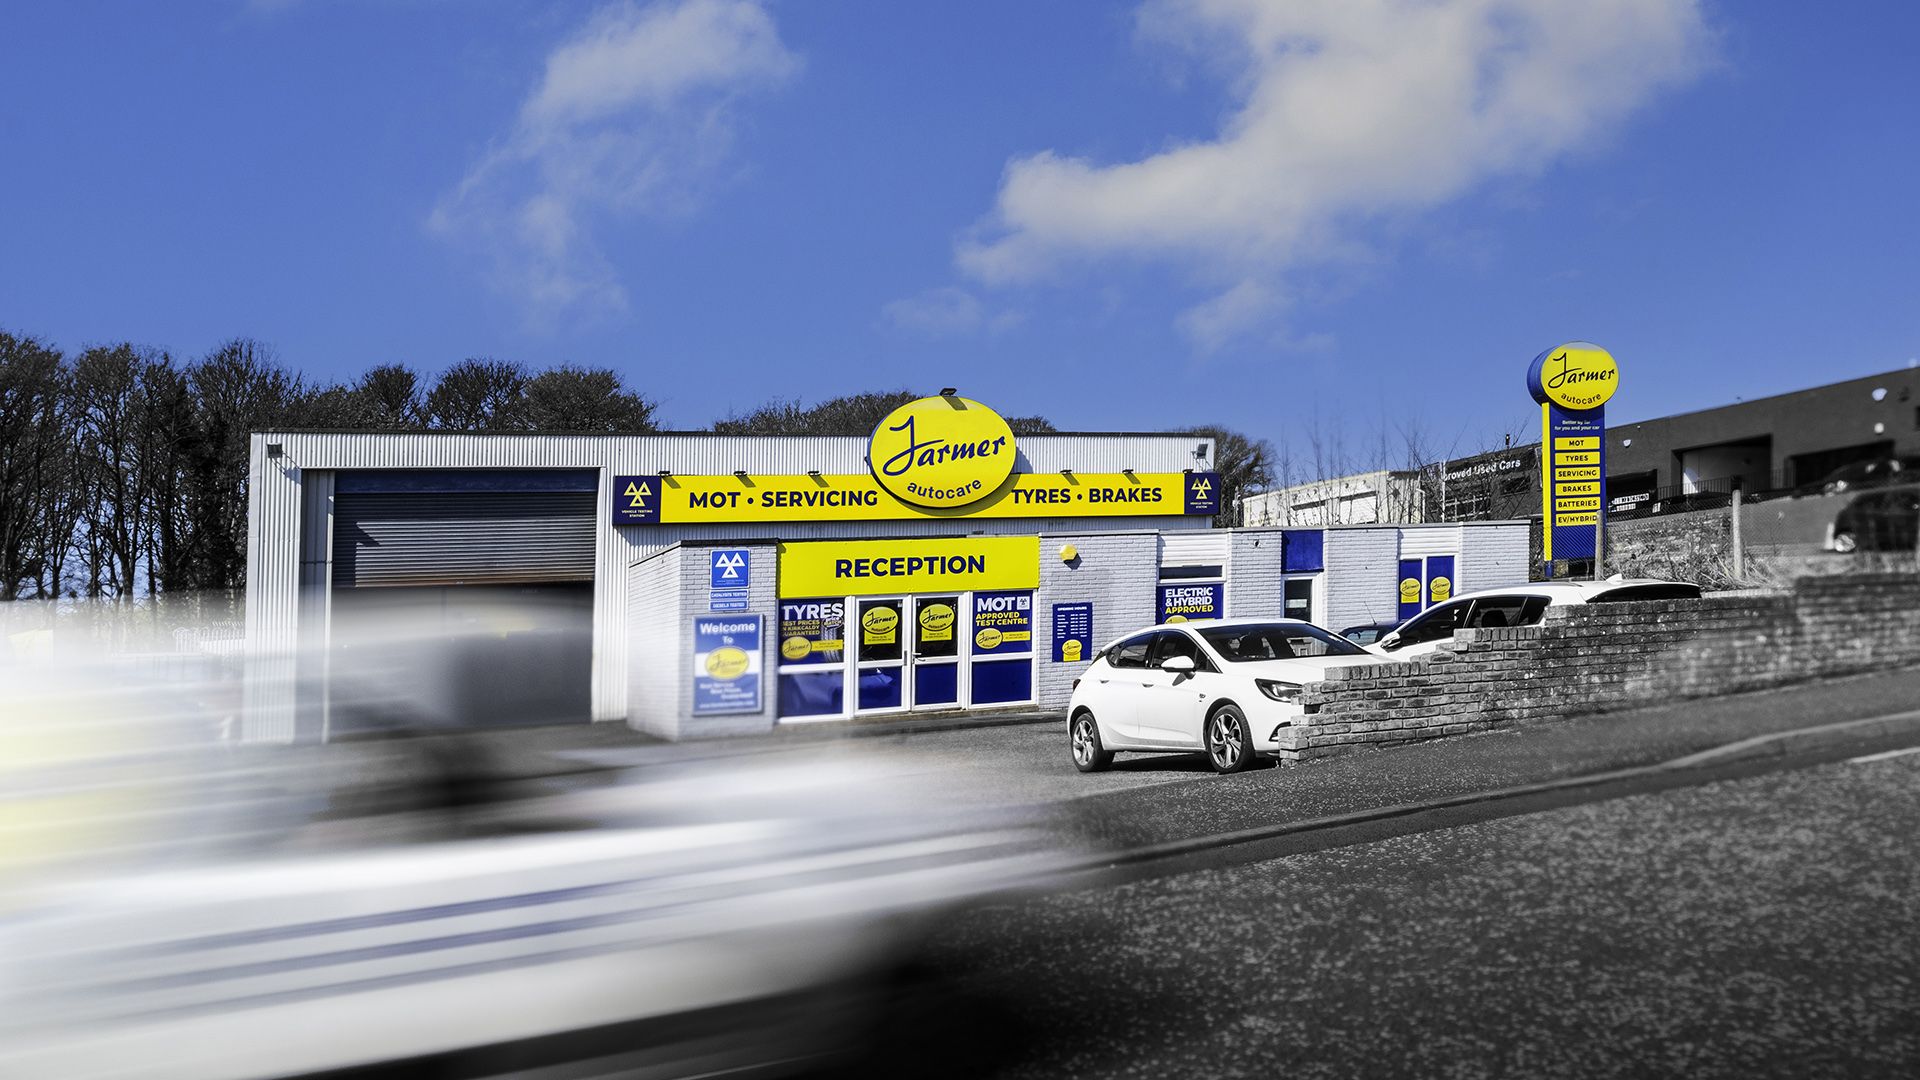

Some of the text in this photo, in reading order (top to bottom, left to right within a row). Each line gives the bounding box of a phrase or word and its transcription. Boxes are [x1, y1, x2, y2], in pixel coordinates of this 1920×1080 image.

[1560, 393, 1602, 405] autocare
[1499, 459, 1521, 470] Cars
[907, 480, 982, 499] autocare
[1563, 485, 1592, 493] BRAKES
[690, 490, 878, 508] MOT SERVICING
[1011, 488, 1163, 504] TYRES BRAKES
[1558, 500, 1597, 508] BATTERIES
[1558, 515, 1598, 523] EV/HYBRID
[836, 555, 985, 579] RECEPTION
[1165, 587, 1213, 598] ELECTRIC
[977, 597, 1016, 612] MOT
[1165, 596, 1213, 607] & HYBRID
[781, 603, 844, 620] TYRES
[1165, 605, 1214, 614] APPROVED
[976, 612, 1020, 620] APPROVED
[700, 622, 756, 634] Welcome
[722, 635, 734, 645] To
